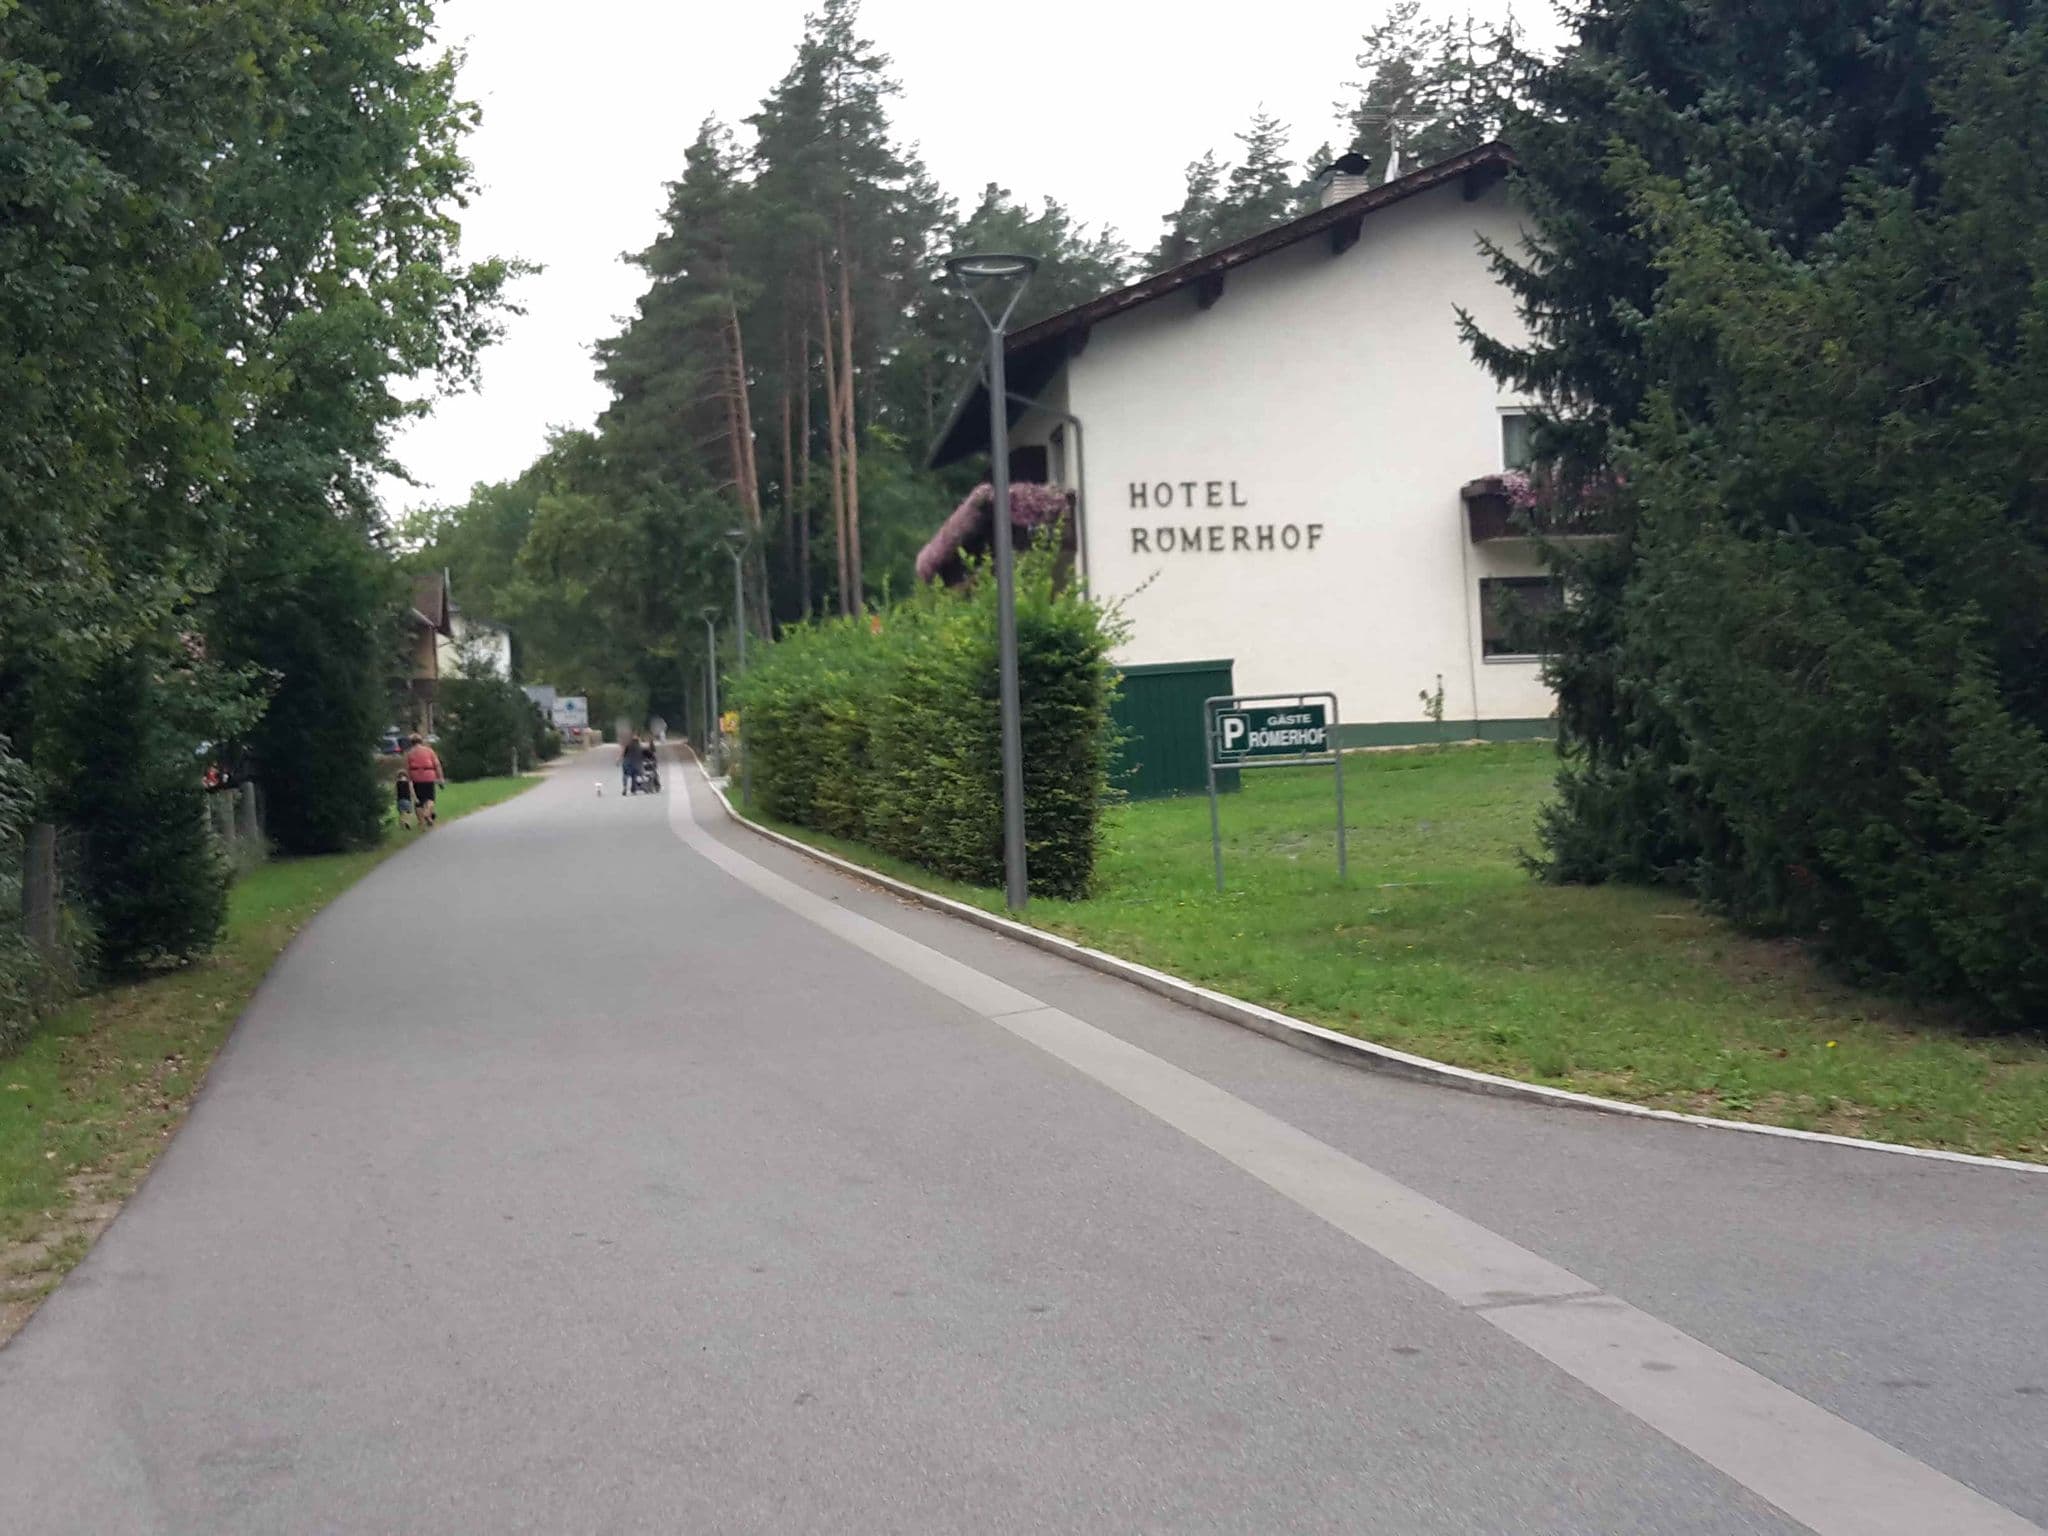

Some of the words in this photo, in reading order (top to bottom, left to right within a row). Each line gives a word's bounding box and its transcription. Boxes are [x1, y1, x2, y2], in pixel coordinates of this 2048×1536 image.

[1129, 481, 1248, 508] HOTEL
[1131, 523, 1324, 553] RÖMERHOF
[1266, 713, 1313, 726] GÄSTE
[1223, 718, 1245, 749] P
[1249, 727, 1328, 748] RÖMERHOF
